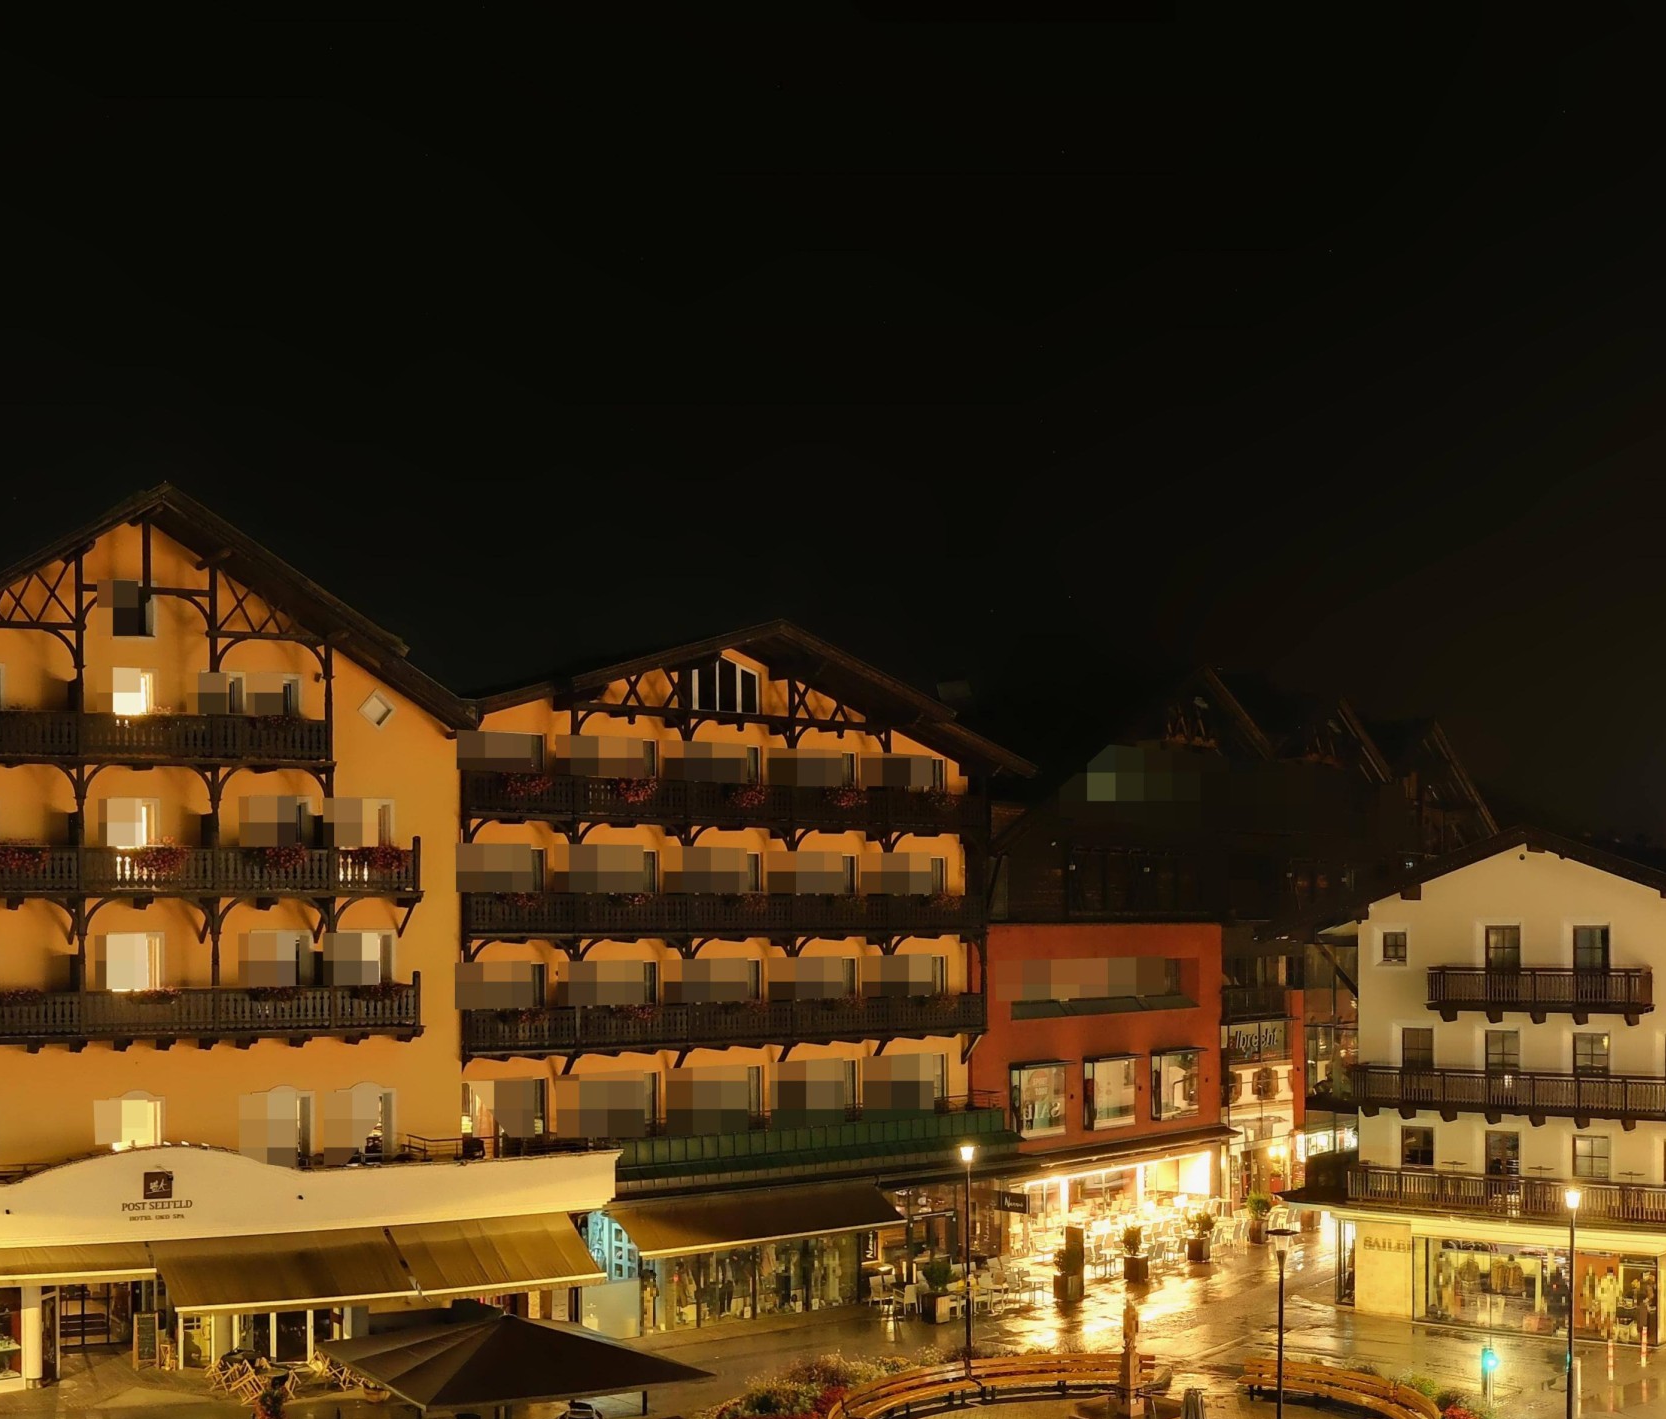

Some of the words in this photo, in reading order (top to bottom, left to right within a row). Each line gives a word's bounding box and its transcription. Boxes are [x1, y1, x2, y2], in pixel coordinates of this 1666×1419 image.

[1235, 1028, 1278, 1050] lbrecht
[121, 1202, 148, 1211] POST
[148, 1200, 193, 1210] SEEFELD
